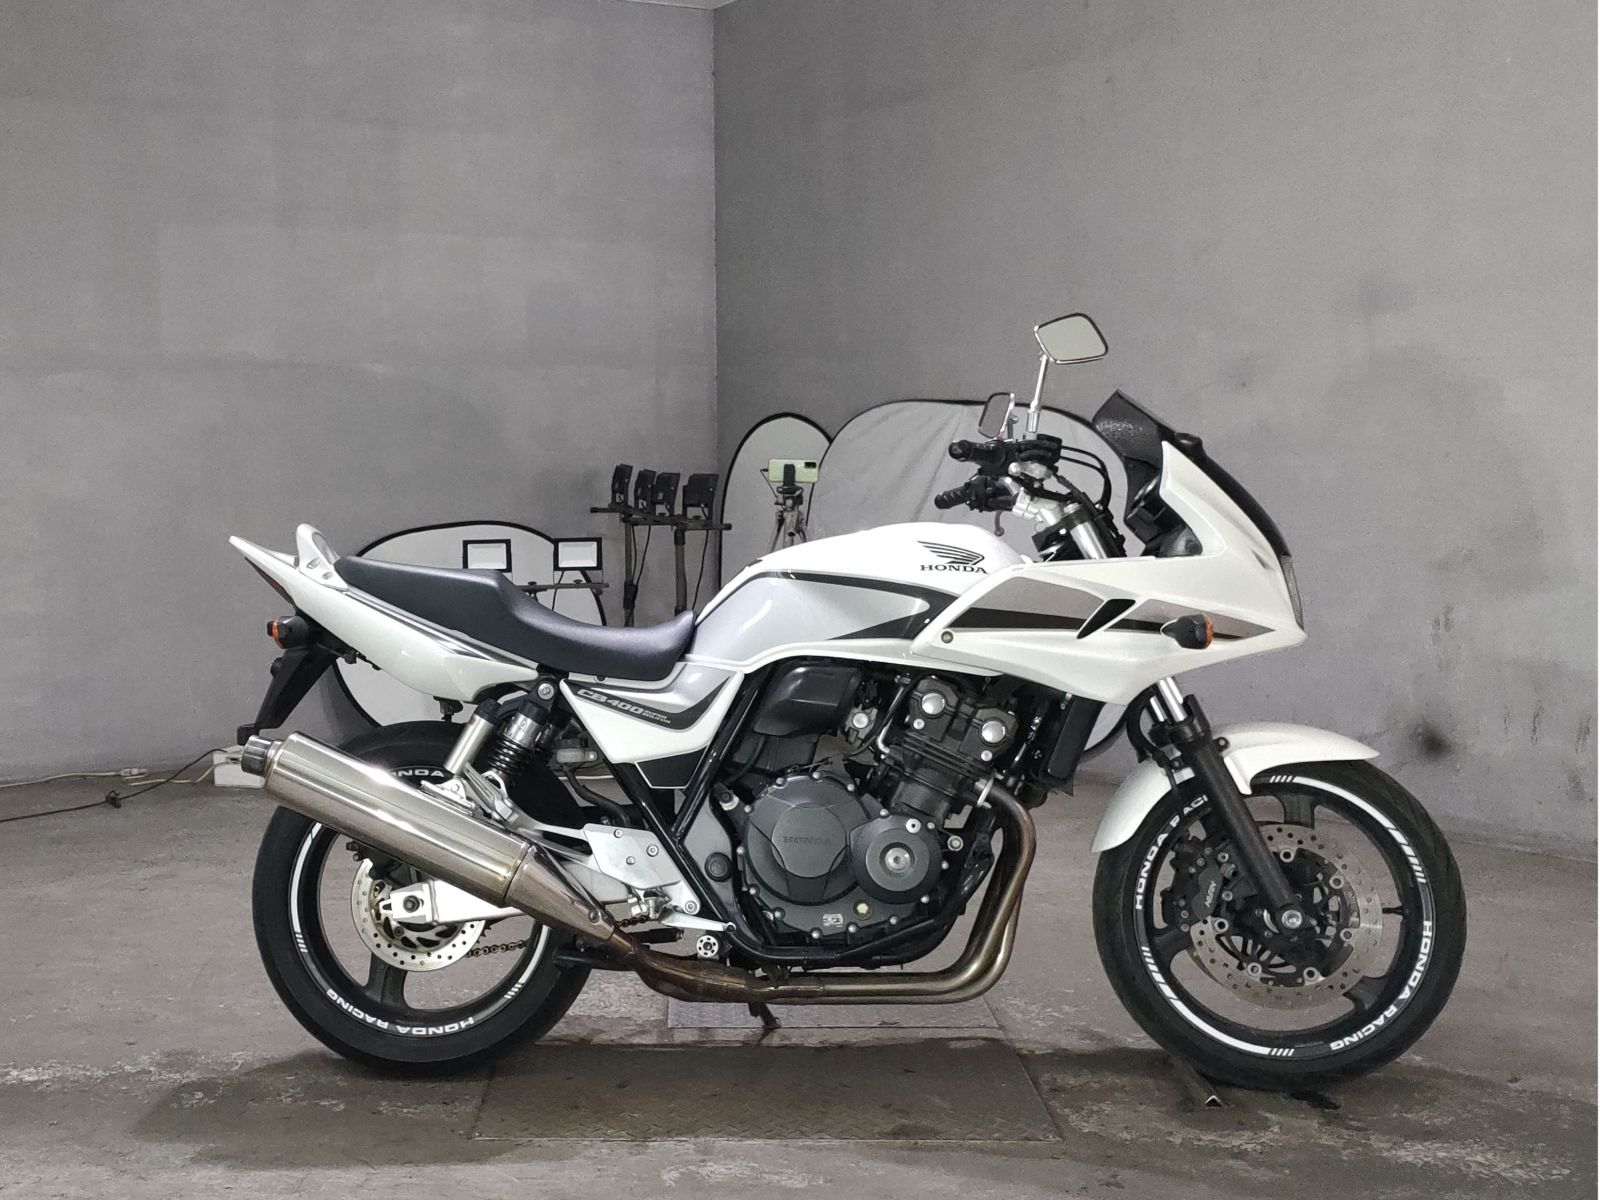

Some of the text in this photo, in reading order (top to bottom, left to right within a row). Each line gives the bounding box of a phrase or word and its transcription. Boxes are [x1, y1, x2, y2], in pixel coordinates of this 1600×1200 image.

[920, 564, 990, 575] HONDA
[391, 769, 445, 778] NDA
[1135, 794, 1209, 910] HONDA RACI
[1329, 920, 1433, 1051] HONDA RACING
[326, 988, 475, 1035] HONDA RACING
